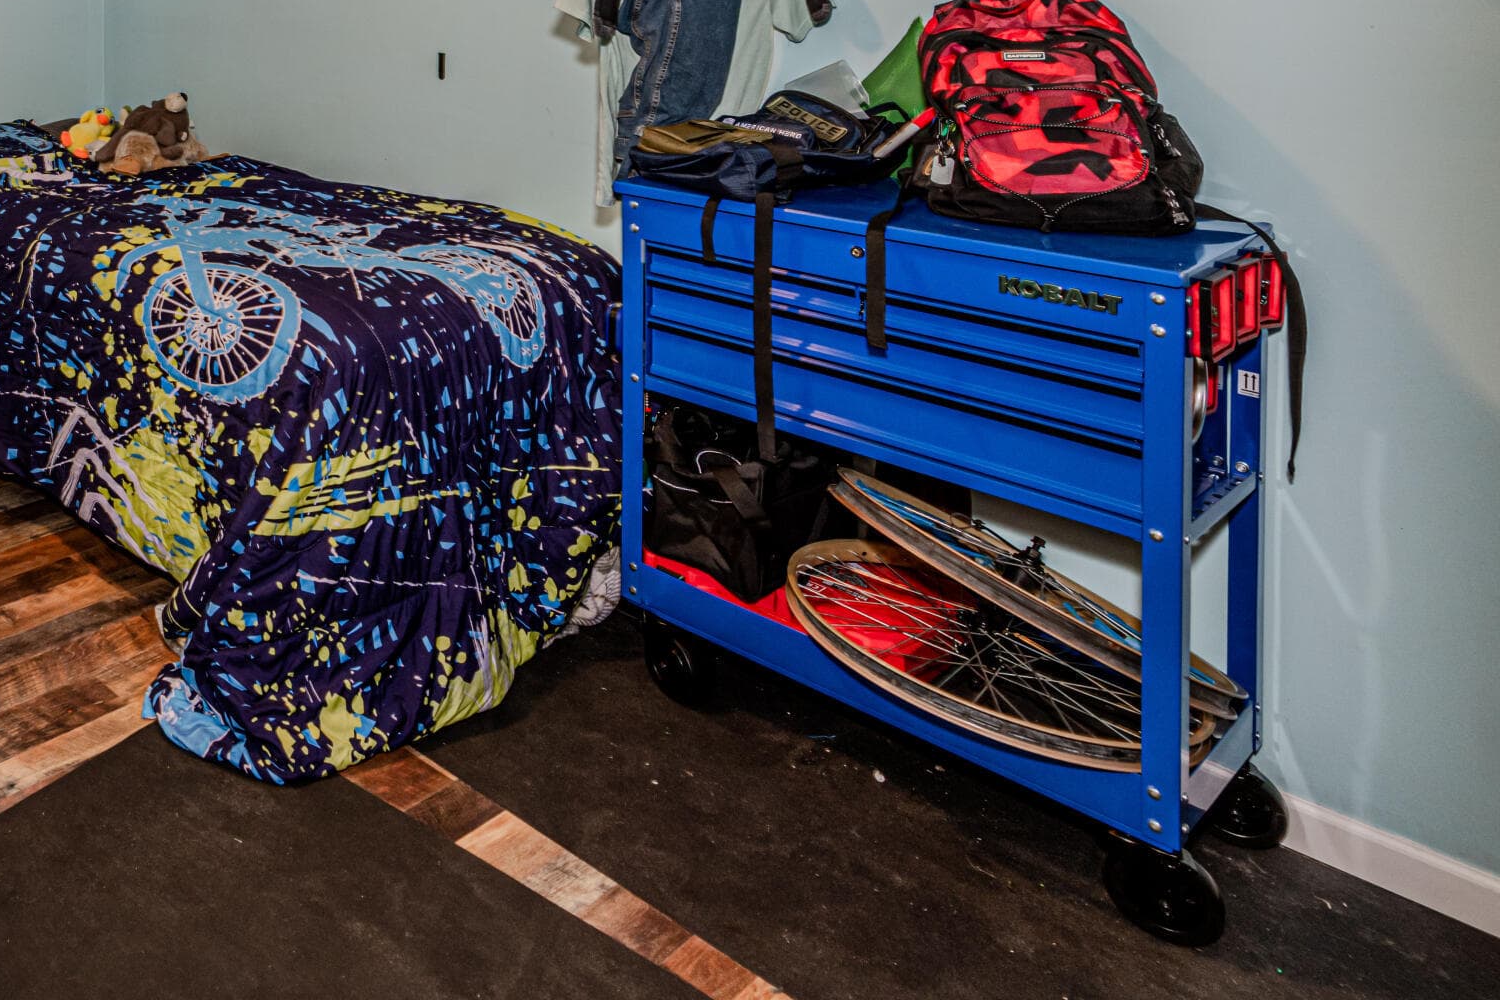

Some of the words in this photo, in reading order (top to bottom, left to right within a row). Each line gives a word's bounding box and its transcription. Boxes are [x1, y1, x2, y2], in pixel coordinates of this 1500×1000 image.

[735, 122, 777, 134] AMERICAN
[778, 129, 802, 140] HERO
[776, 100, 842, 137] POLICE
[998, 274, 1123, 315] KOBALT
